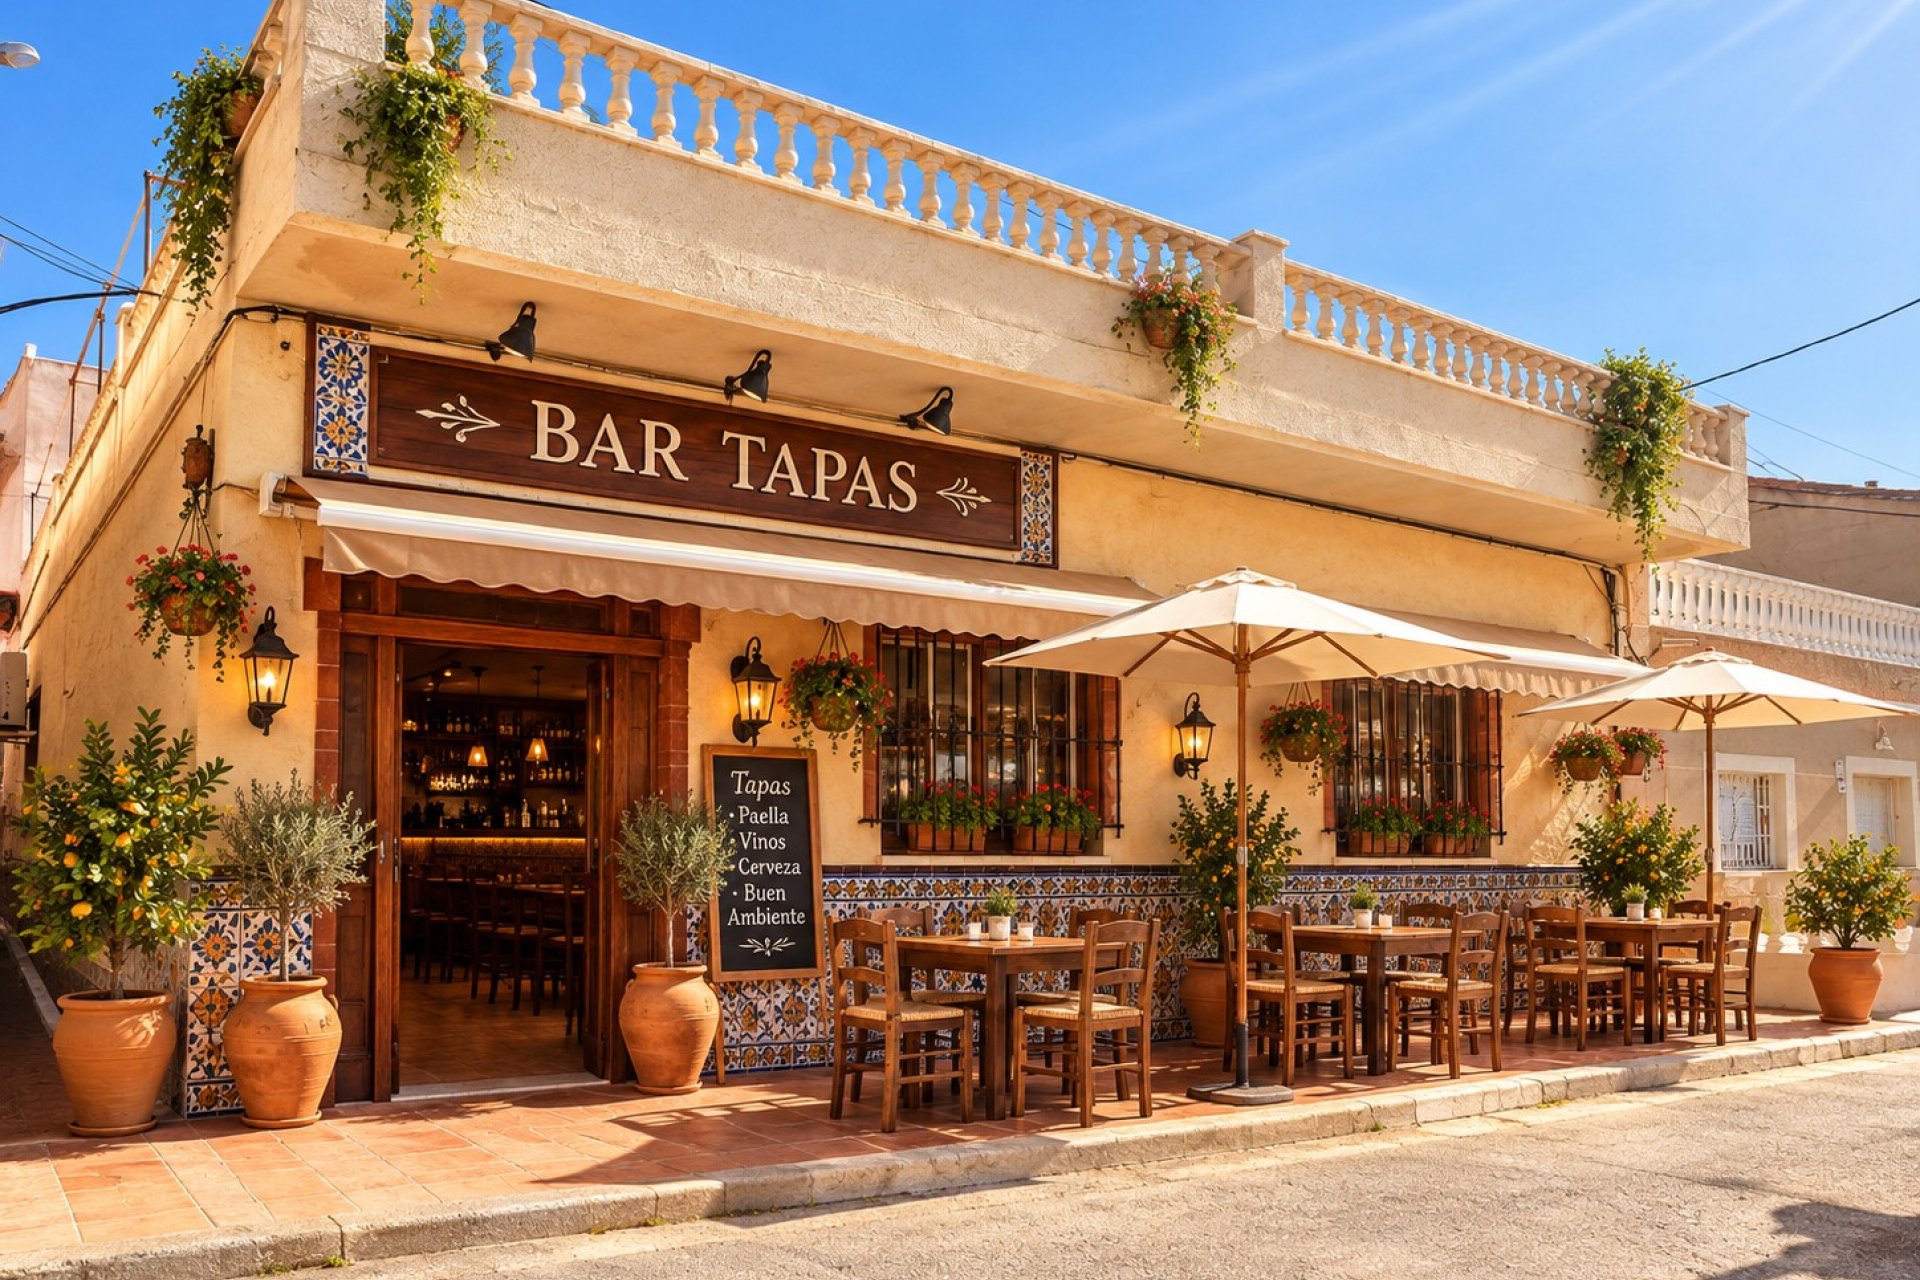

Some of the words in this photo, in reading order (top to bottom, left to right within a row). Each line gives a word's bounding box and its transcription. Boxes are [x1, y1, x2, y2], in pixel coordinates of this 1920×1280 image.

[530, 399, 690, 482] BAR
[721, 430, 918, 514] TAPAS
[730, 770, 791, 801] Tapas
[738, 805, 789, 825] Paella
[739, 831, 786, 850] Vinos
[738, 857, 802, 876] Cerveza
[744, 883, 786, 902] Buen
[727, 907, 806, 927] Ambiente
